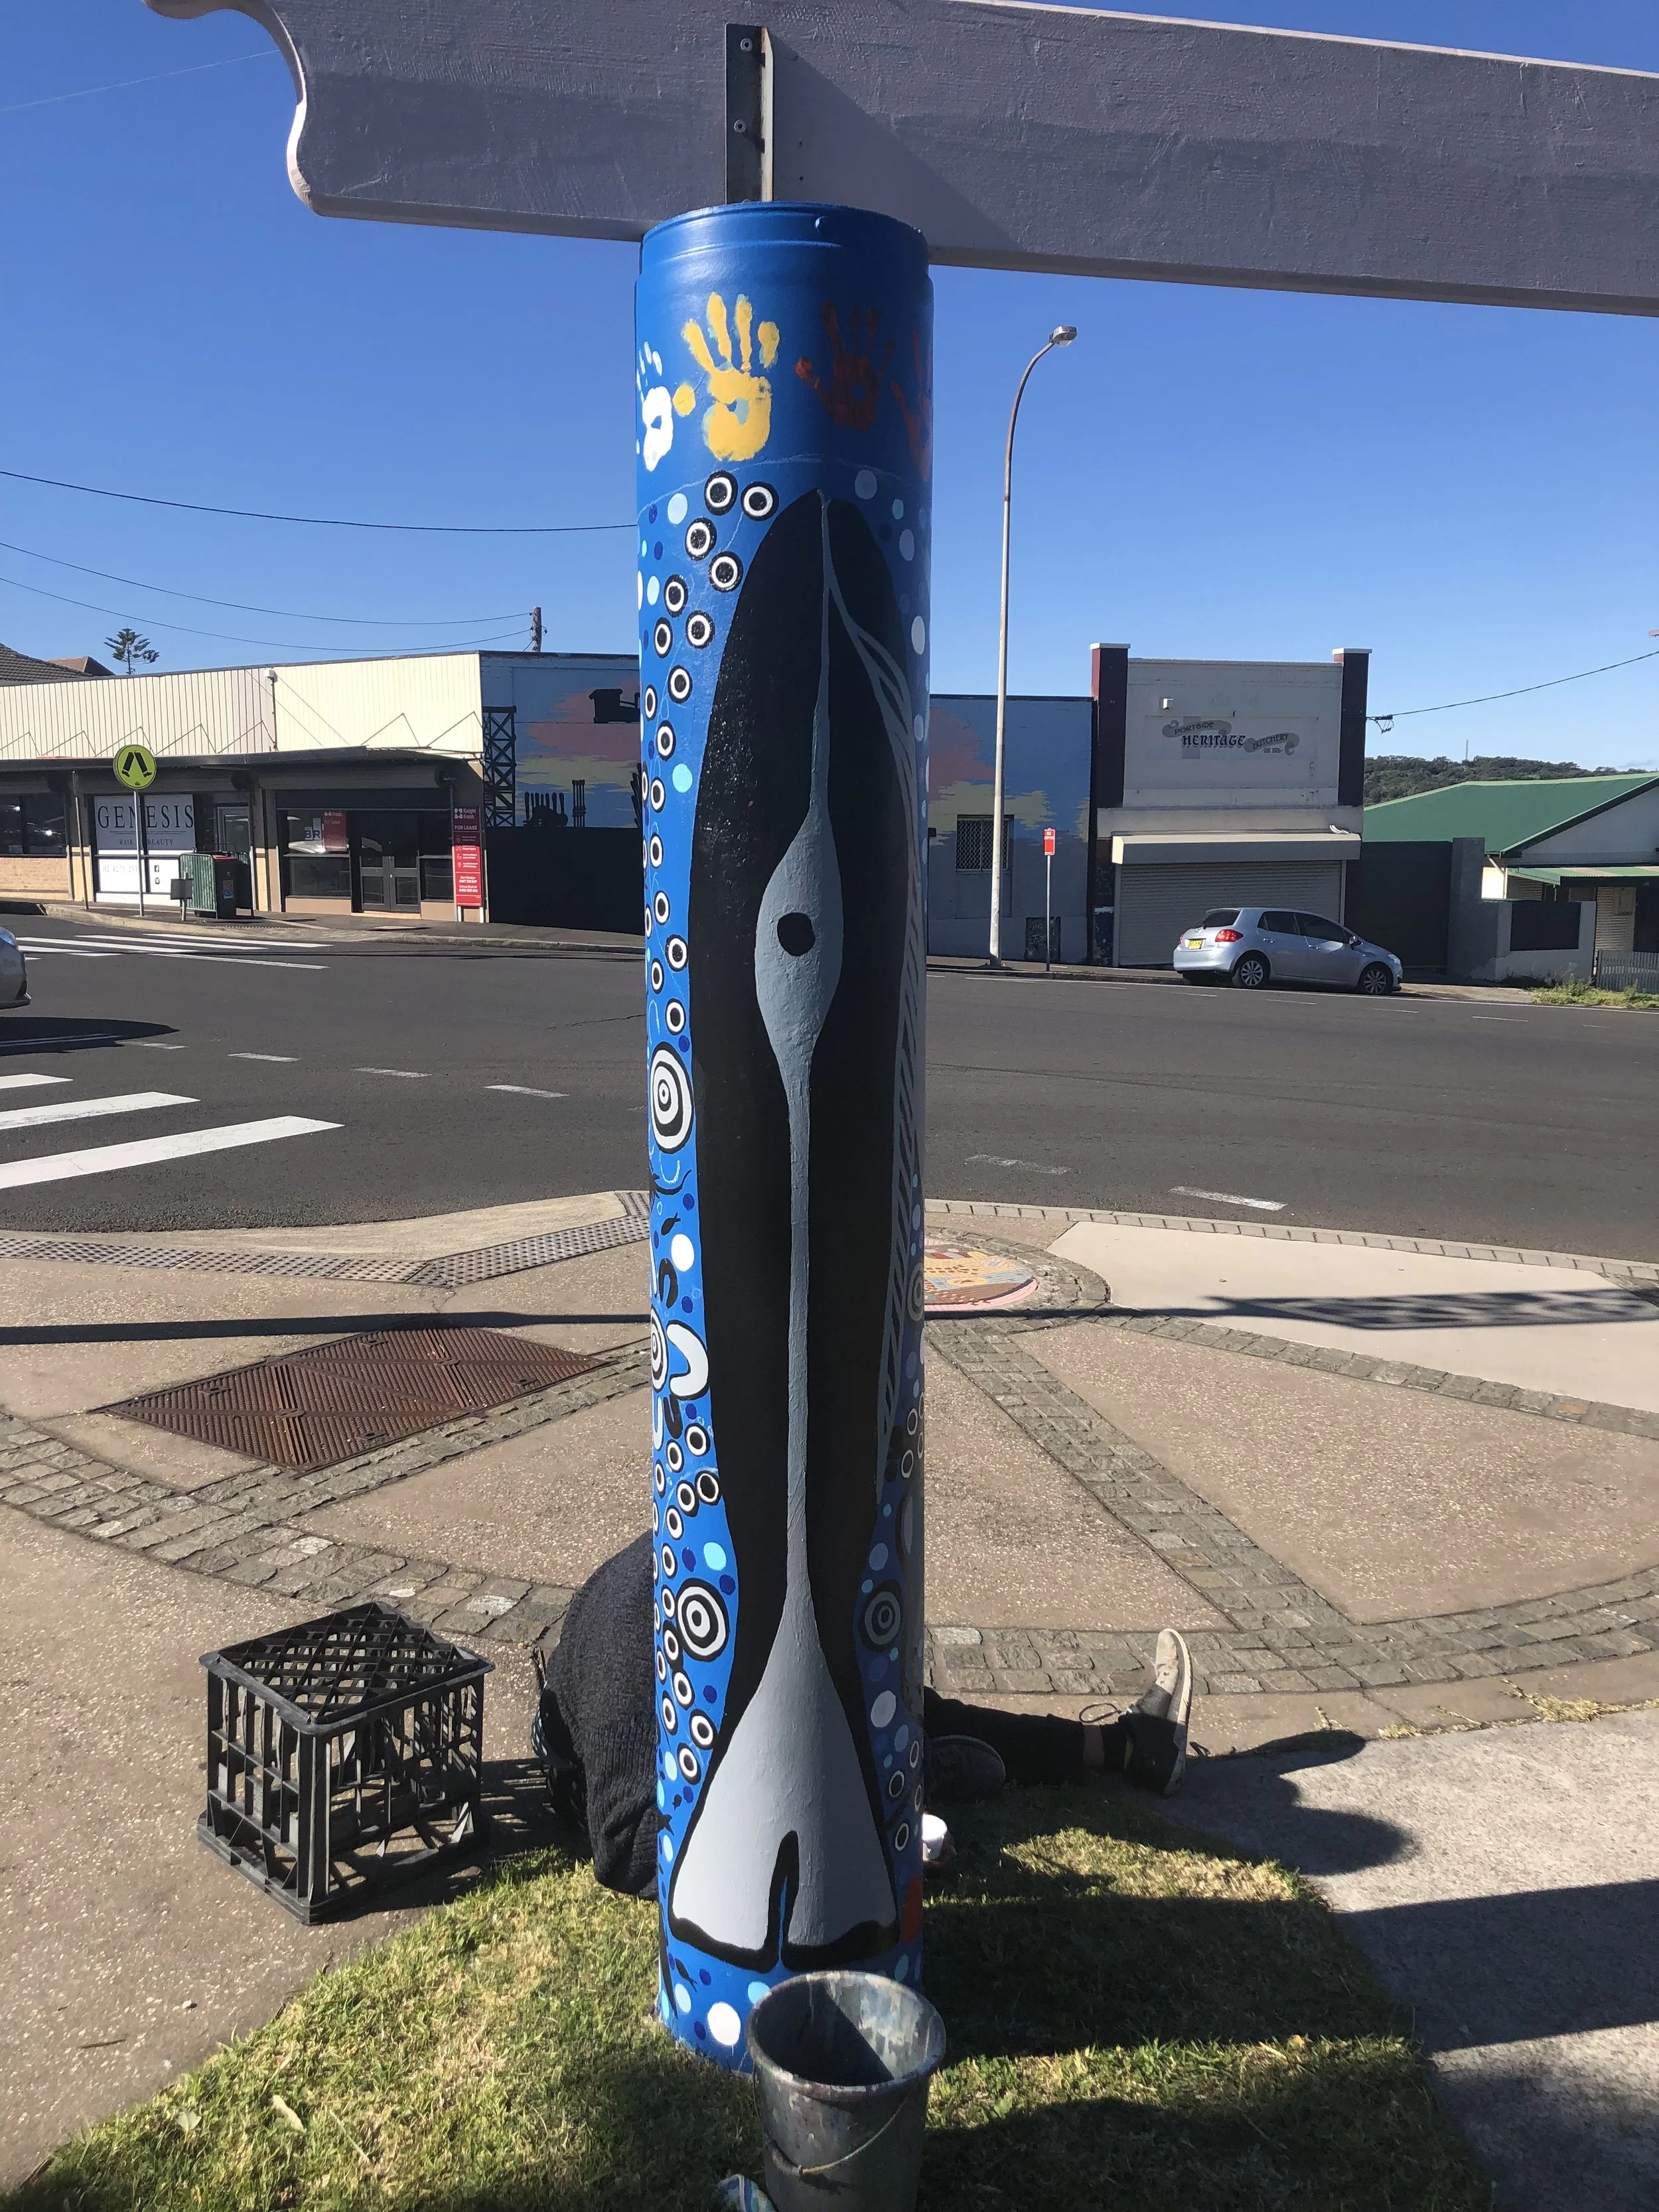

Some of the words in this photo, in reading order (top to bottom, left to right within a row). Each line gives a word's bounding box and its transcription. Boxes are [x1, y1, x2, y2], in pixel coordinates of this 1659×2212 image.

[1174, 721, 1214, 735] PORTSIDE
[1182, 735, 1246, 746] HERITAGE
[1252, 733, 1288, 749] BUTCHERY
[98, 804, 194, 828] GENESIS
